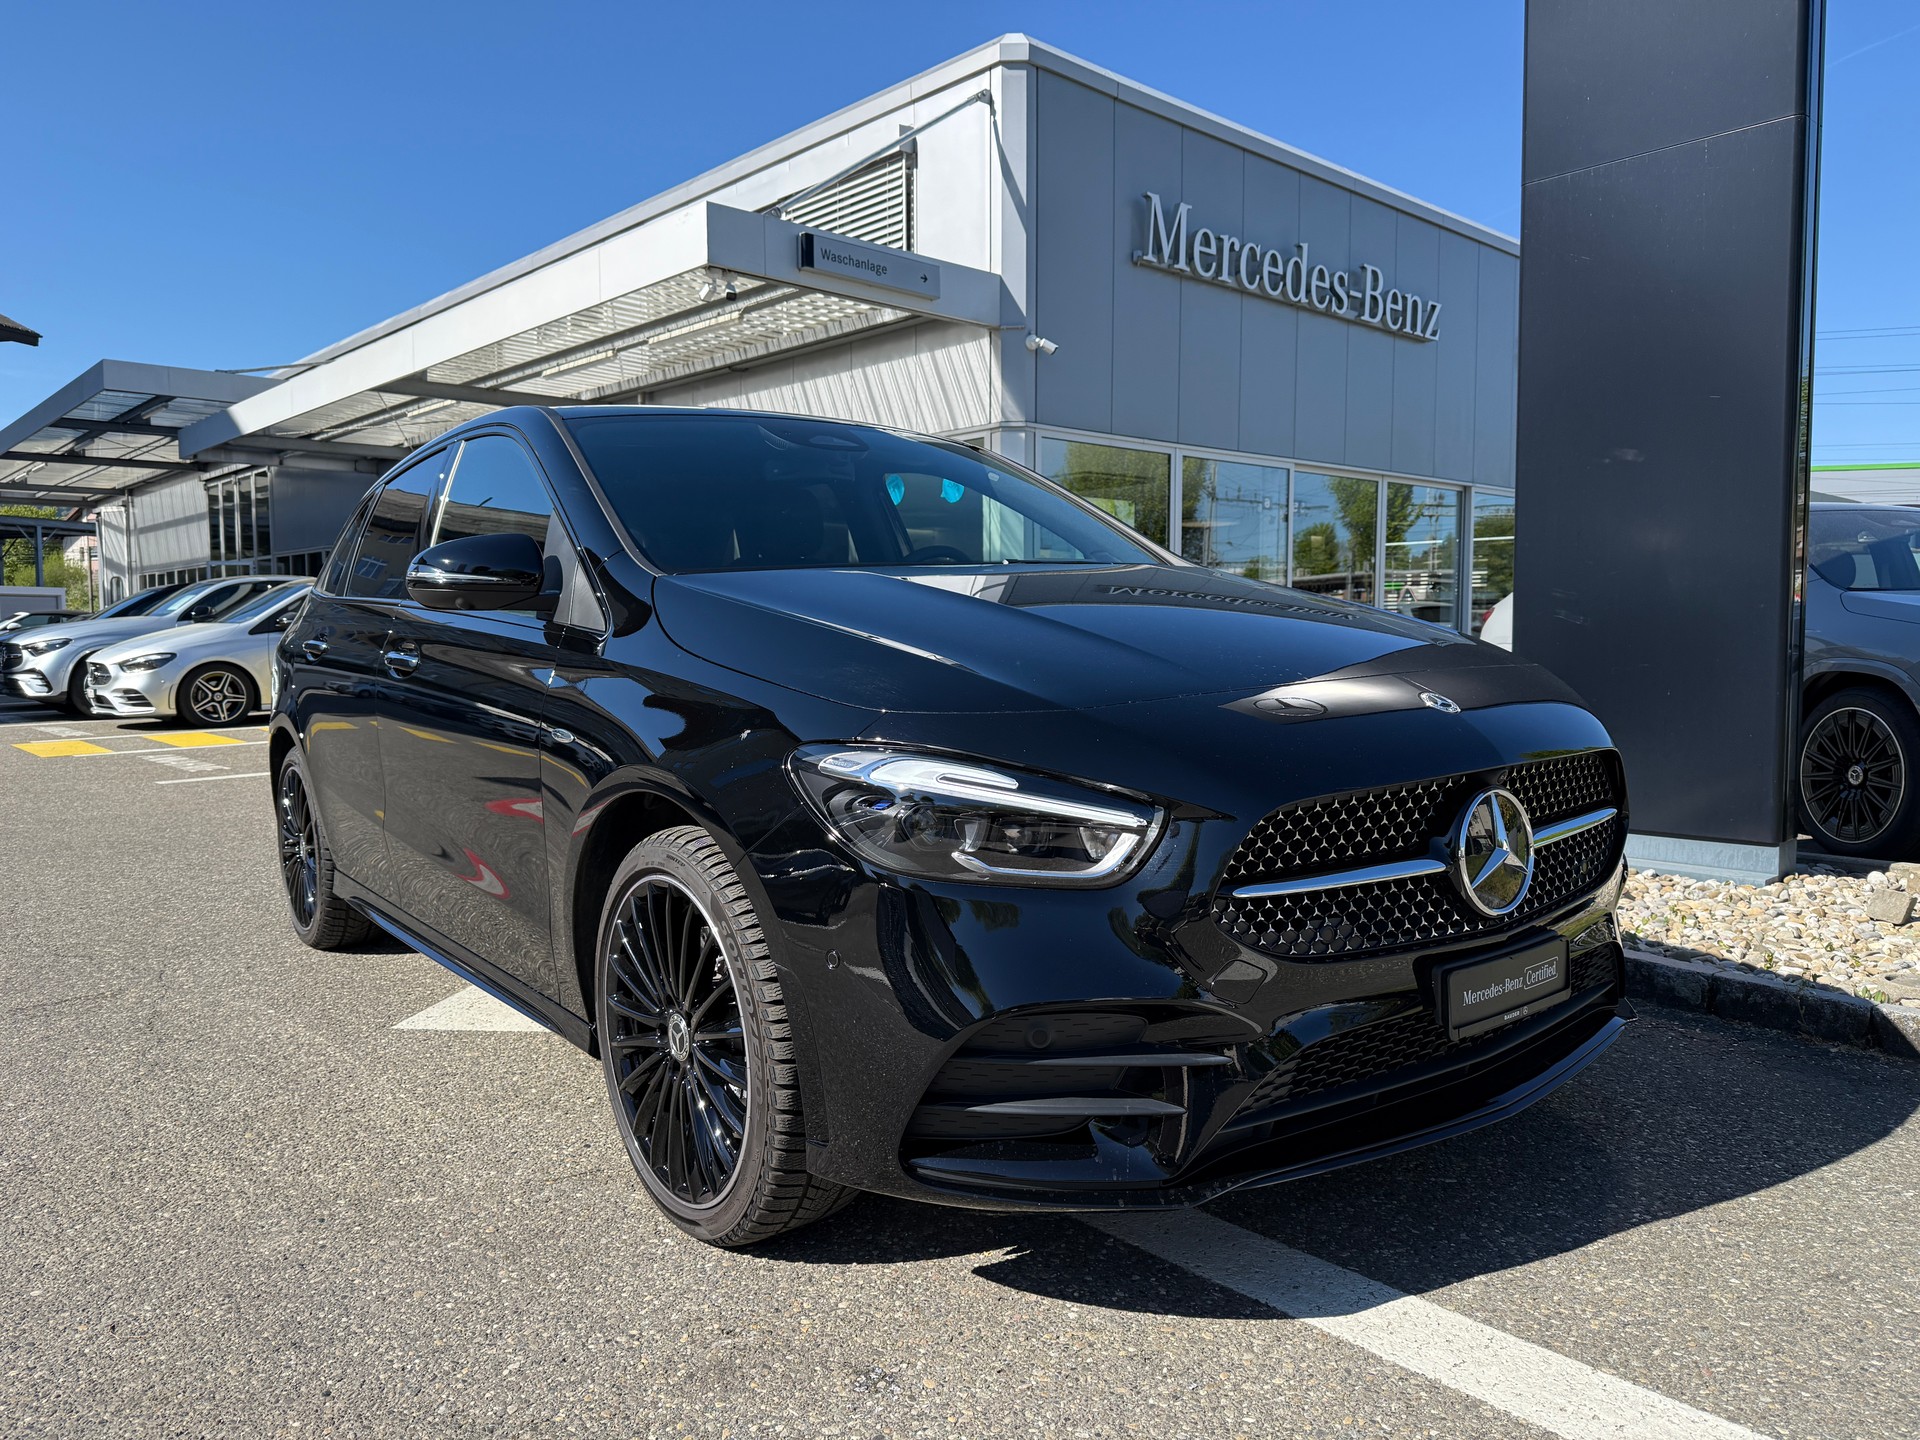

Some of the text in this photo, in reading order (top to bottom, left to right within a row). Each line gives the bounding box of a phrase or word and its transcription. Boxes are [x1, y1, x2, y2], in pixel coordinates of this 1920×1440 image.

[820, 247, 888, 276] Waschanlage
[1142, 191, 1443, 342] Mercedes-Benz
[721, 920, 763, 1106] SOTTOZERO
[1462, 961, 1557, 1006] Mercedes-Benz Certified
